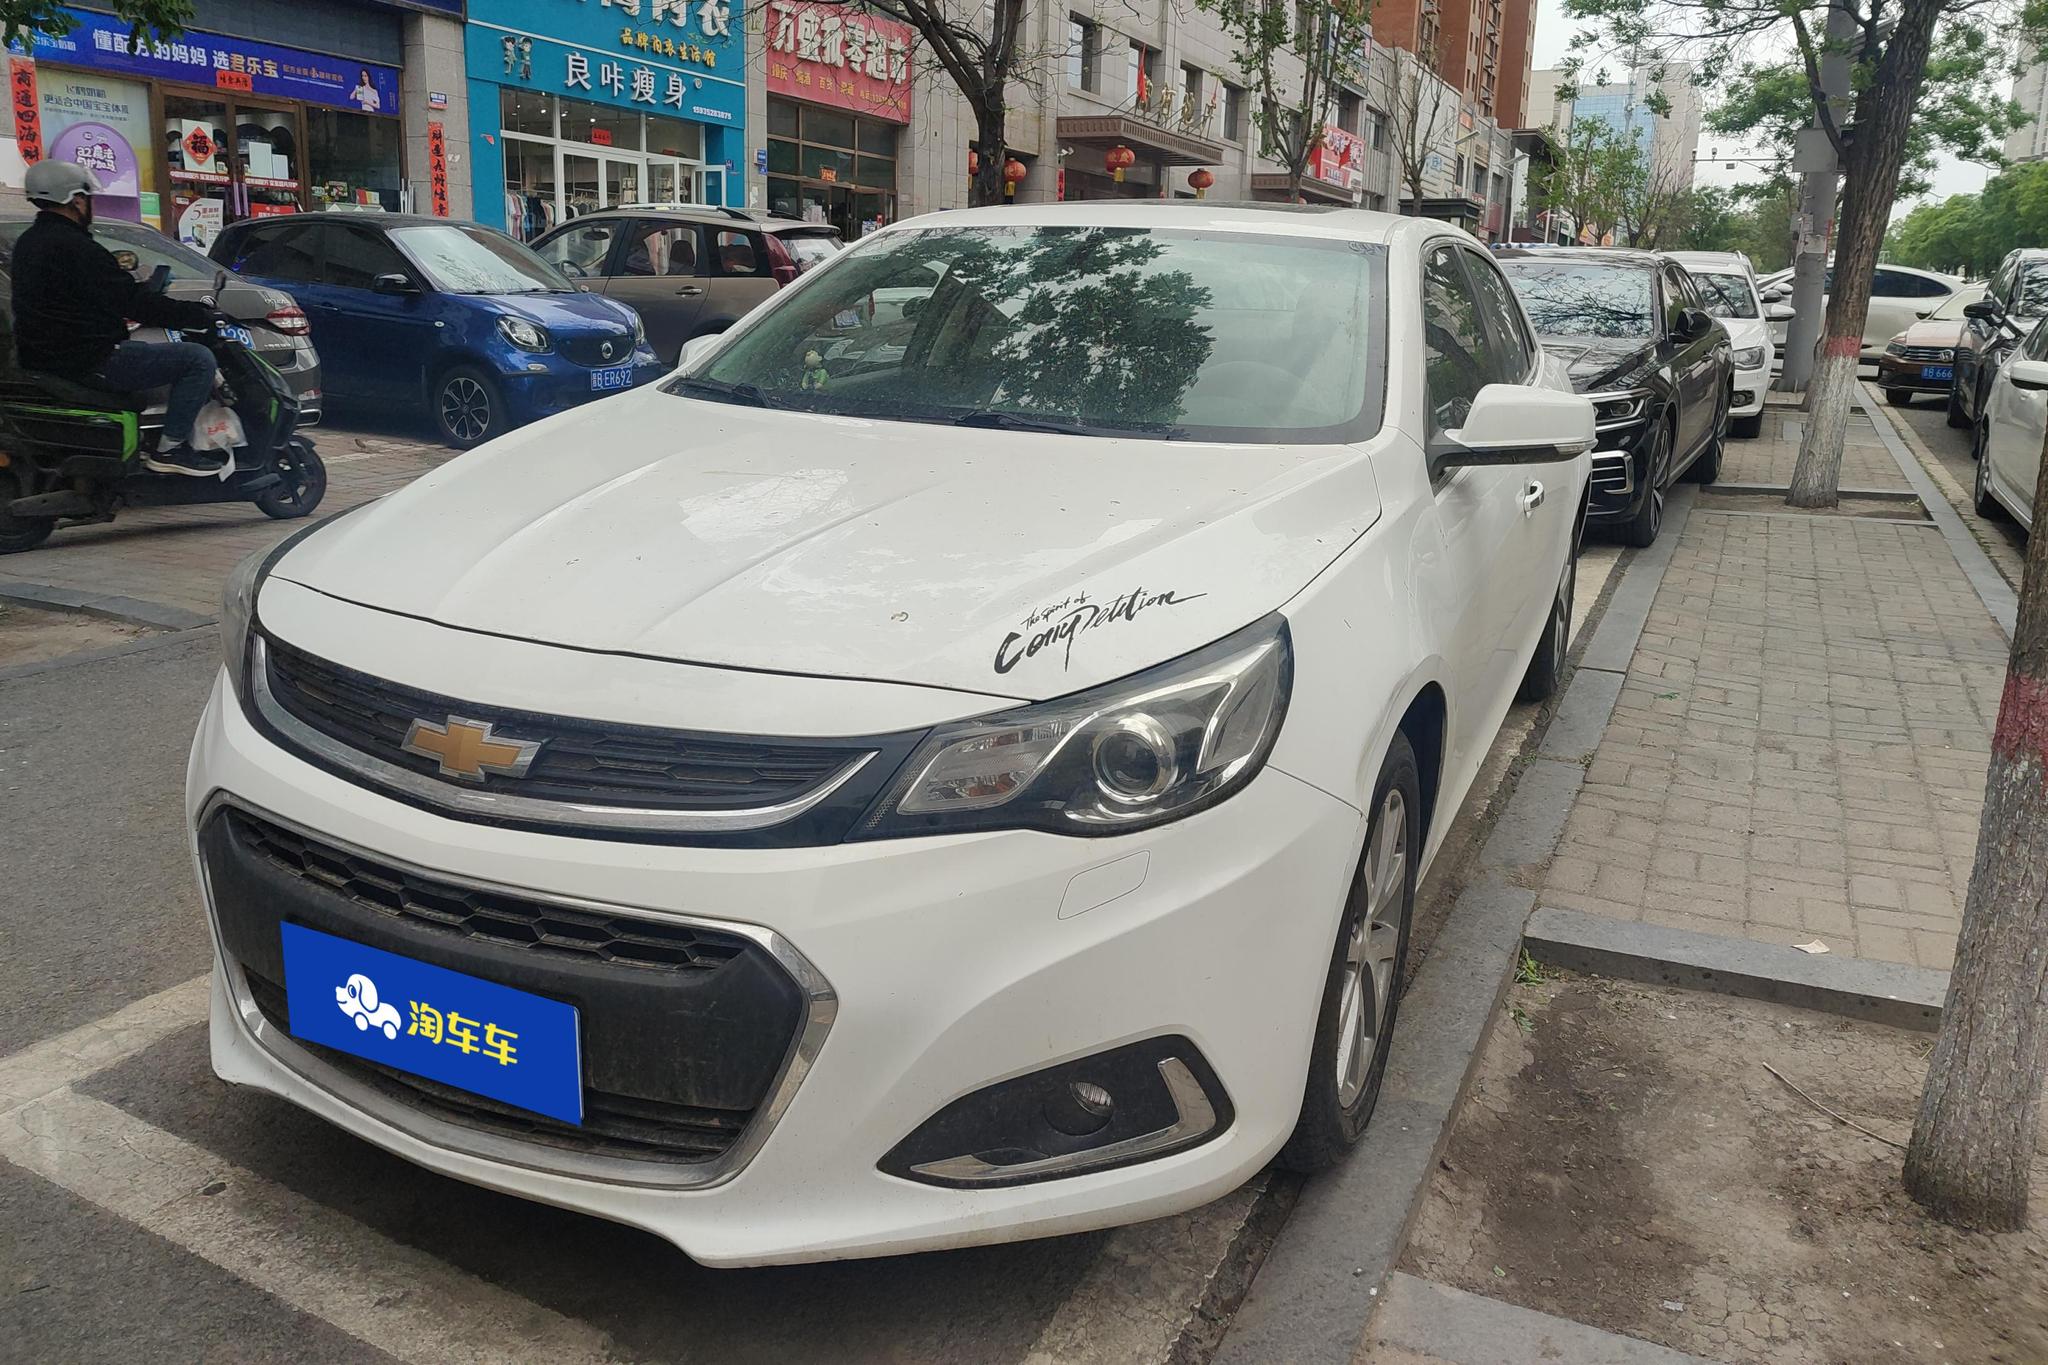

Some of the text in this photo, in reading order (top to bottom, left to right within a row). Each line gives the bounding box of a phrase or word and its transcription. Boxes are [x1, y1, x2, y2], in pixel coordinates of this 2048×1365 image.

[620, 27, 717, 68] 品牌内衣生活馆
[564, 51, 687, 110] 良咔瘦身
[191, 133, 210, 155] 福
